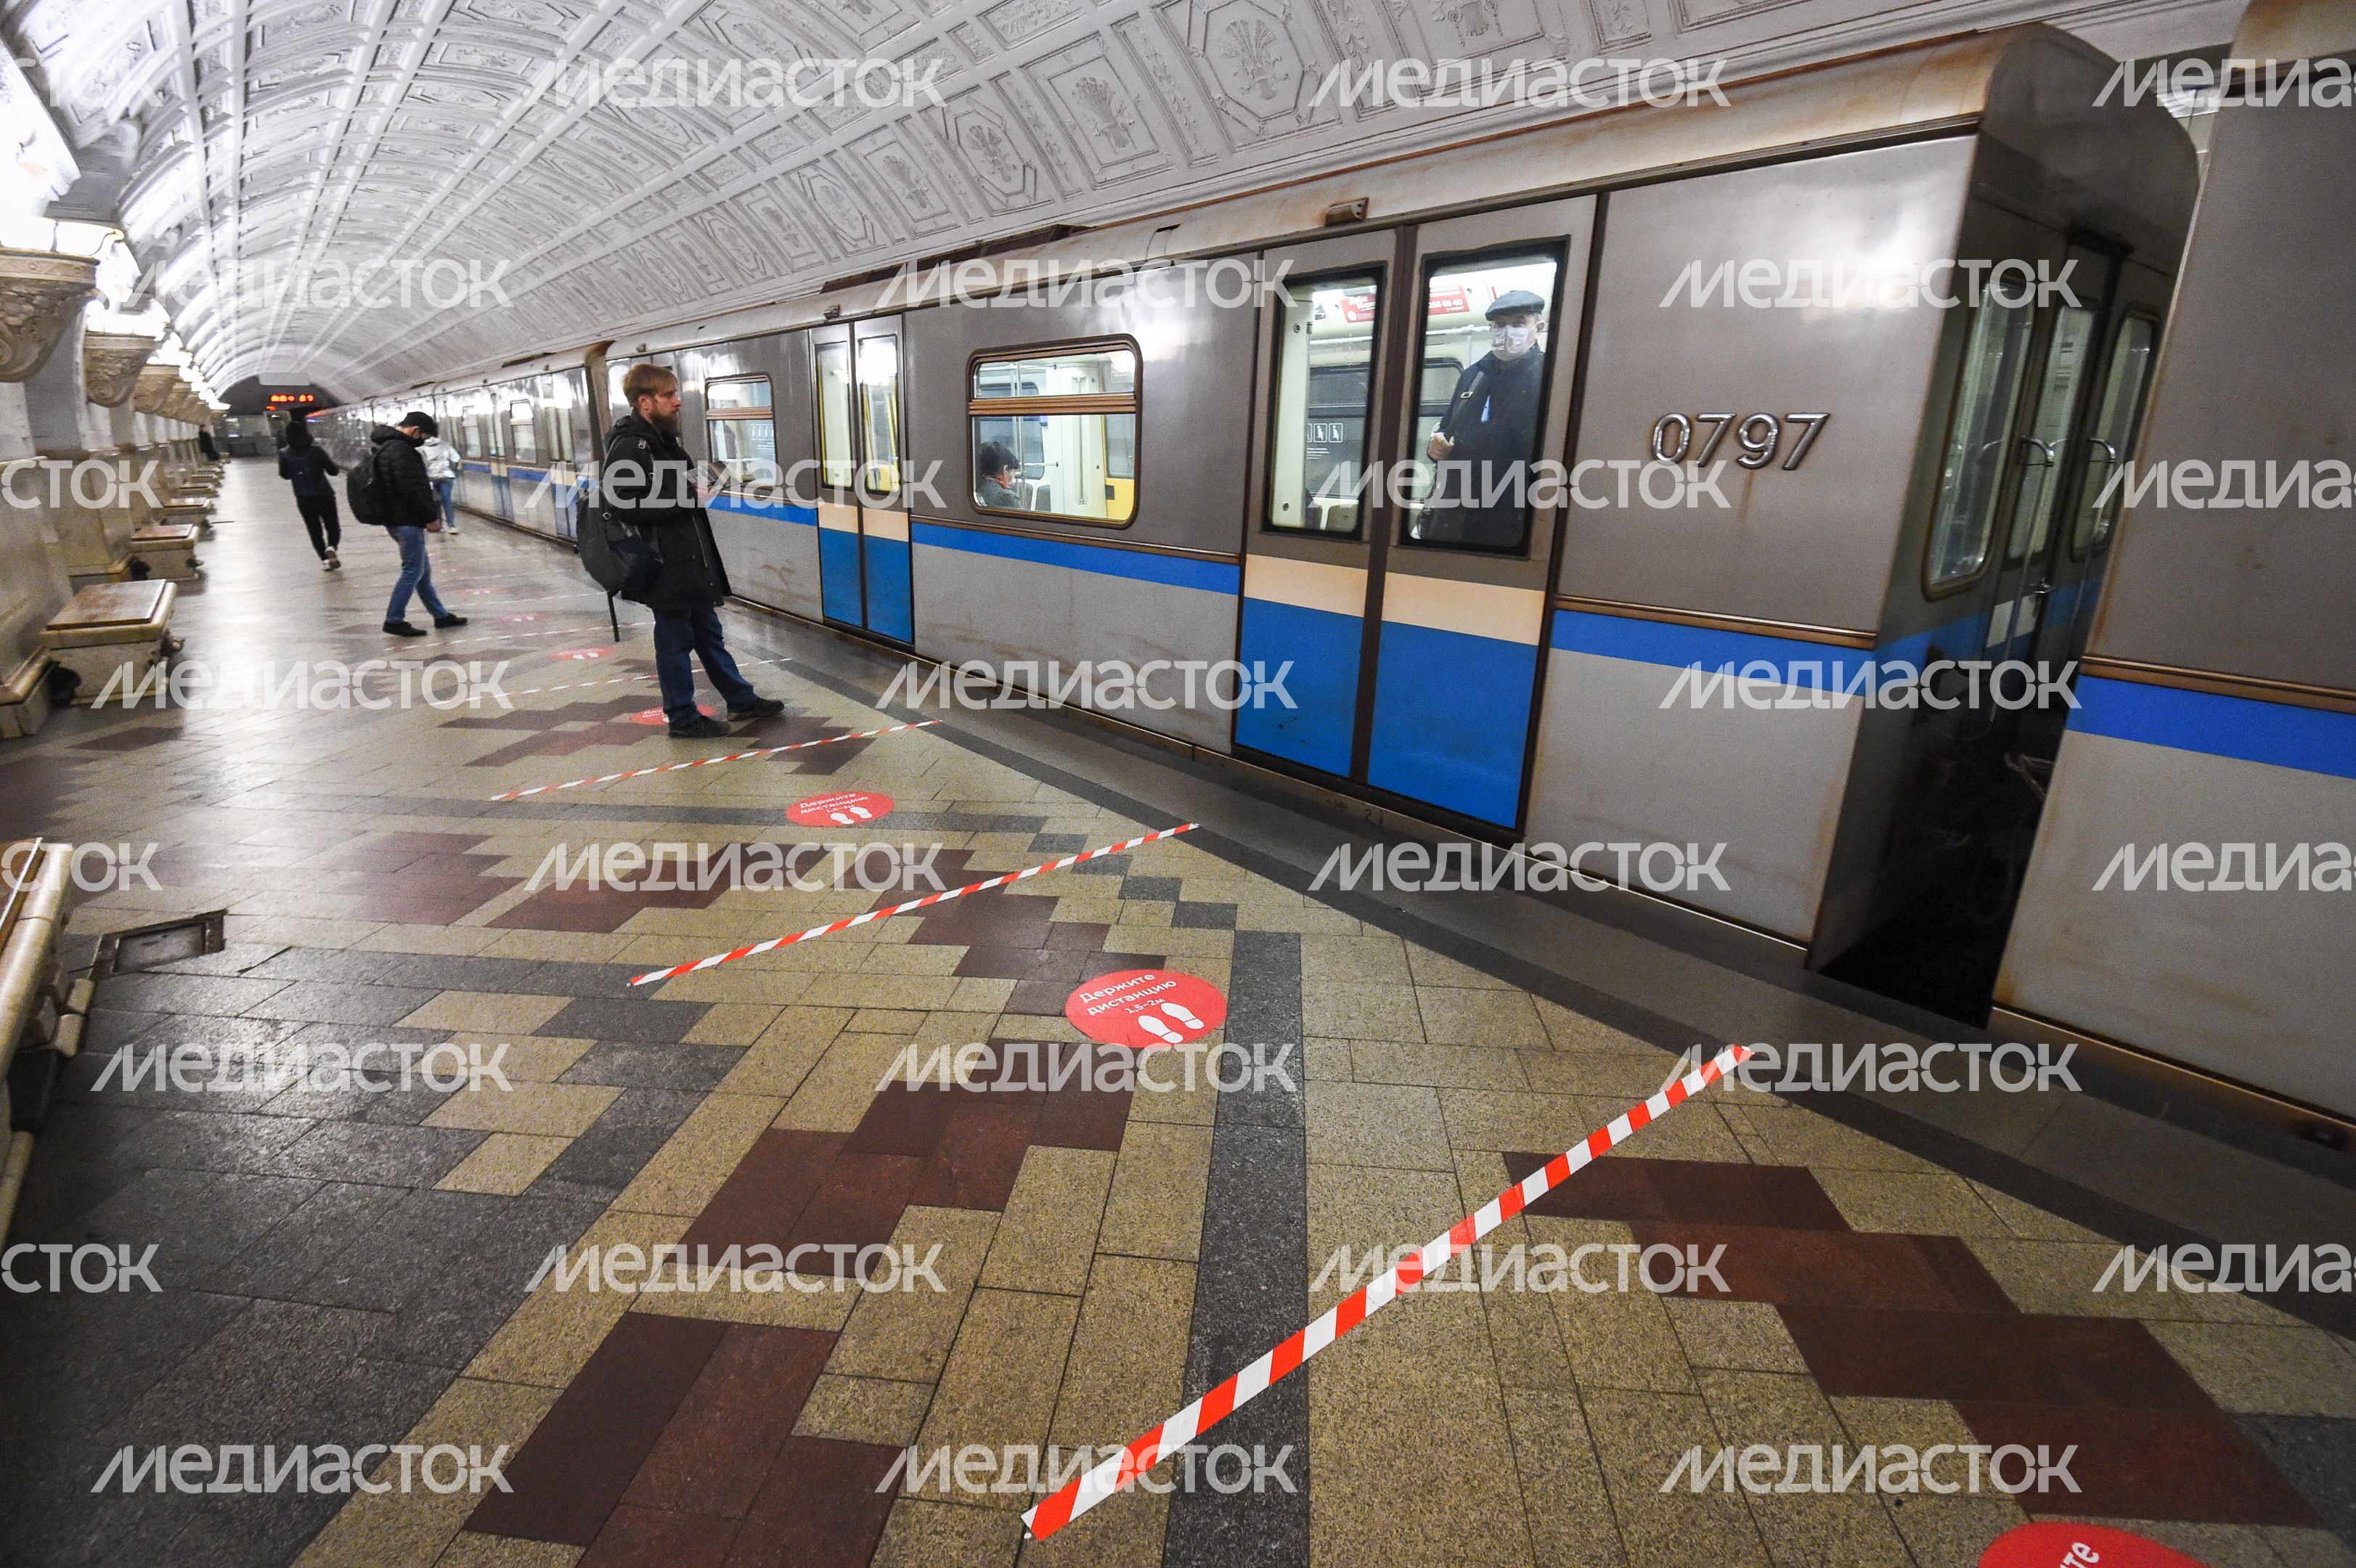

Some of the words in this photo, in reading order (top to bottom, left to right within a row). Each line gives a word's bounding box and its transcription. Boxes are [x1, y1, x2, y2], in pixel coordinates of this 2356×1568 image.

[1651, 412, 1830, 470] 0797
[800, 793, 856, 809] Держите
[1080, 973, 1156, 1003] Держите
[1086, 980, 1178, 1016] дистанцию
